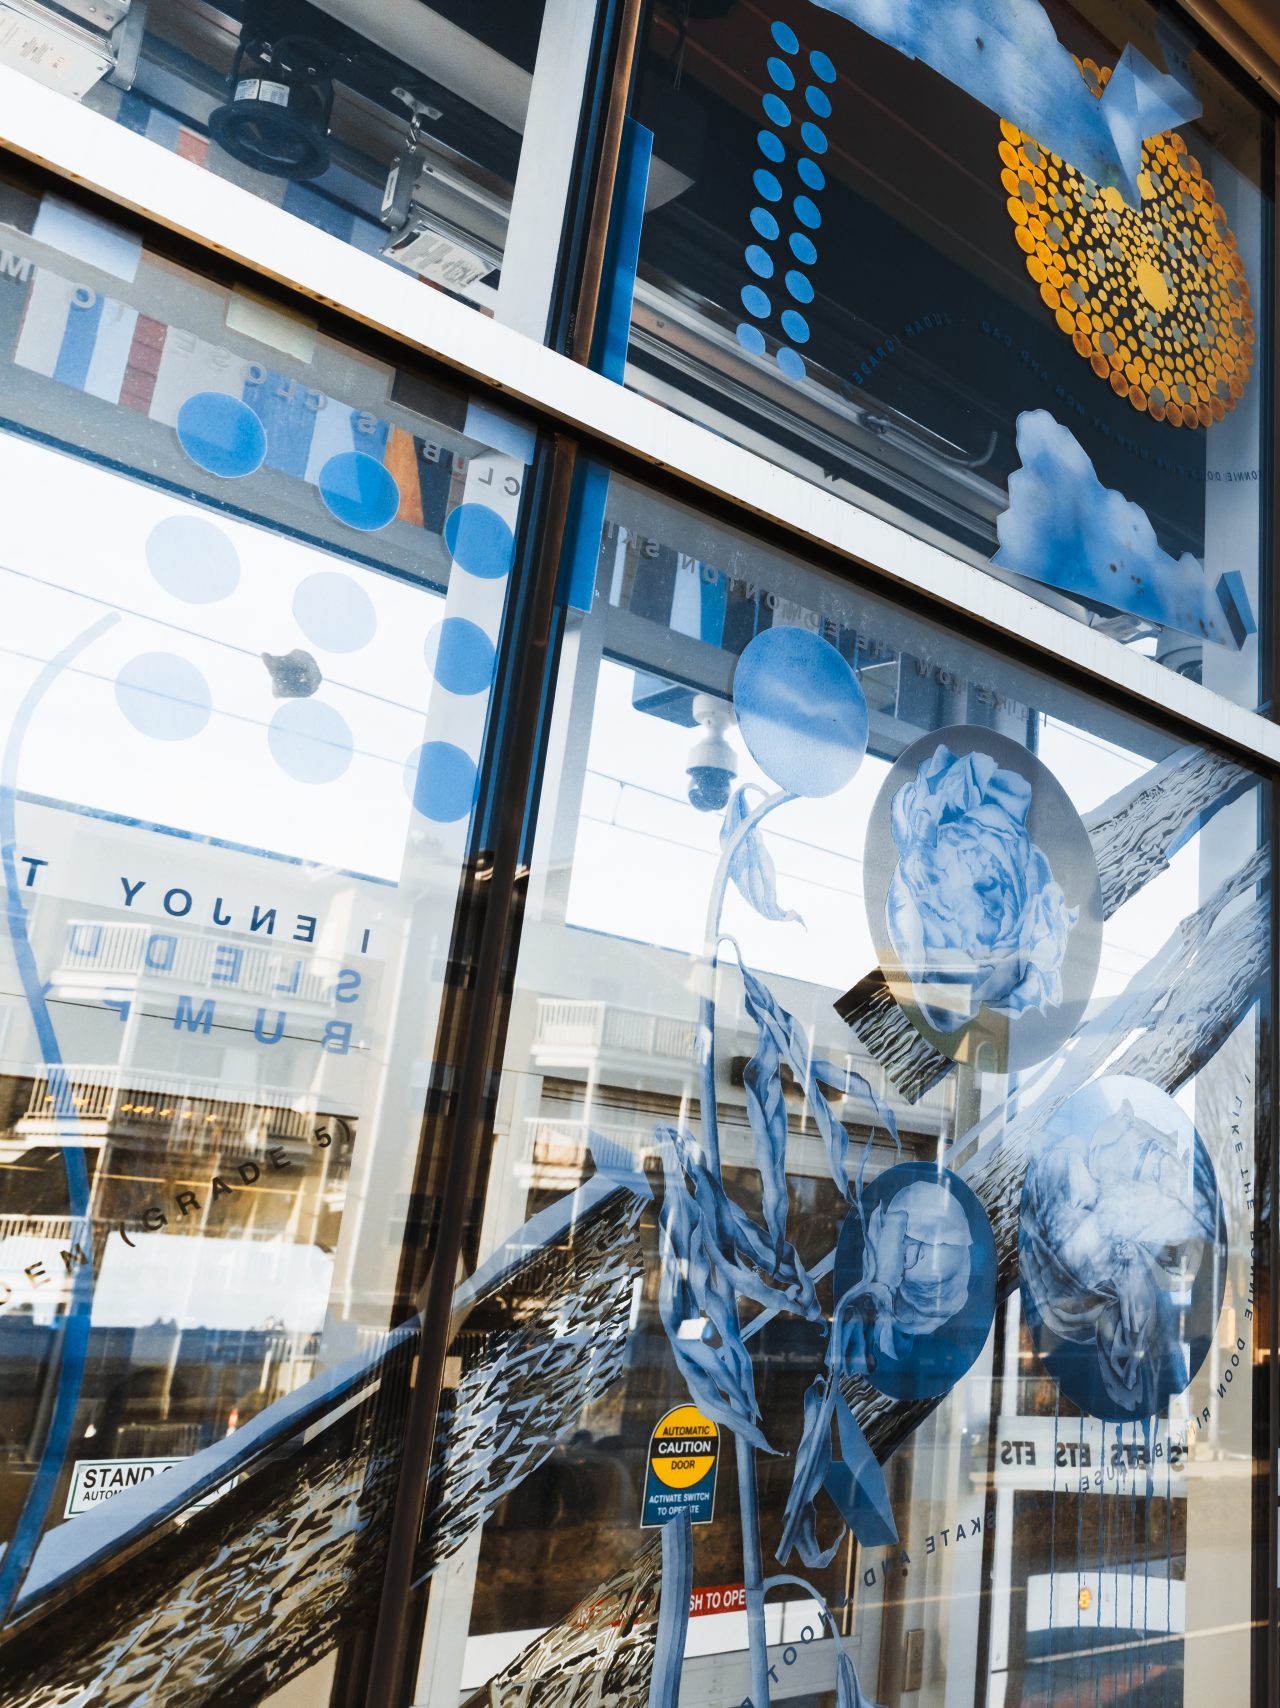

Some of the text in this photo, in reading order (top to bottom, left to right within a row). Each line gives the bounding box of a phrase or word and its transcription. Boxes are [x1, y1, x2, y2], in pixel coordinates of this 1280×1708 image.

[119, 1145, 291, 1247] (GRADE
[314, 1118, 351, 1148] 5)
[662, 1425, 711, 1437] AUTOMATIC
[658, 1440, 712, 1454] CAUTION
[671, 1459, 696, 1471] DOOR
[649, 1492, 710, 1504] ACTIVATE SWITCH
[657, 1505, 700, 1516] TO OPETE
[688, 1588, 746, 1612] SH TO OPE
